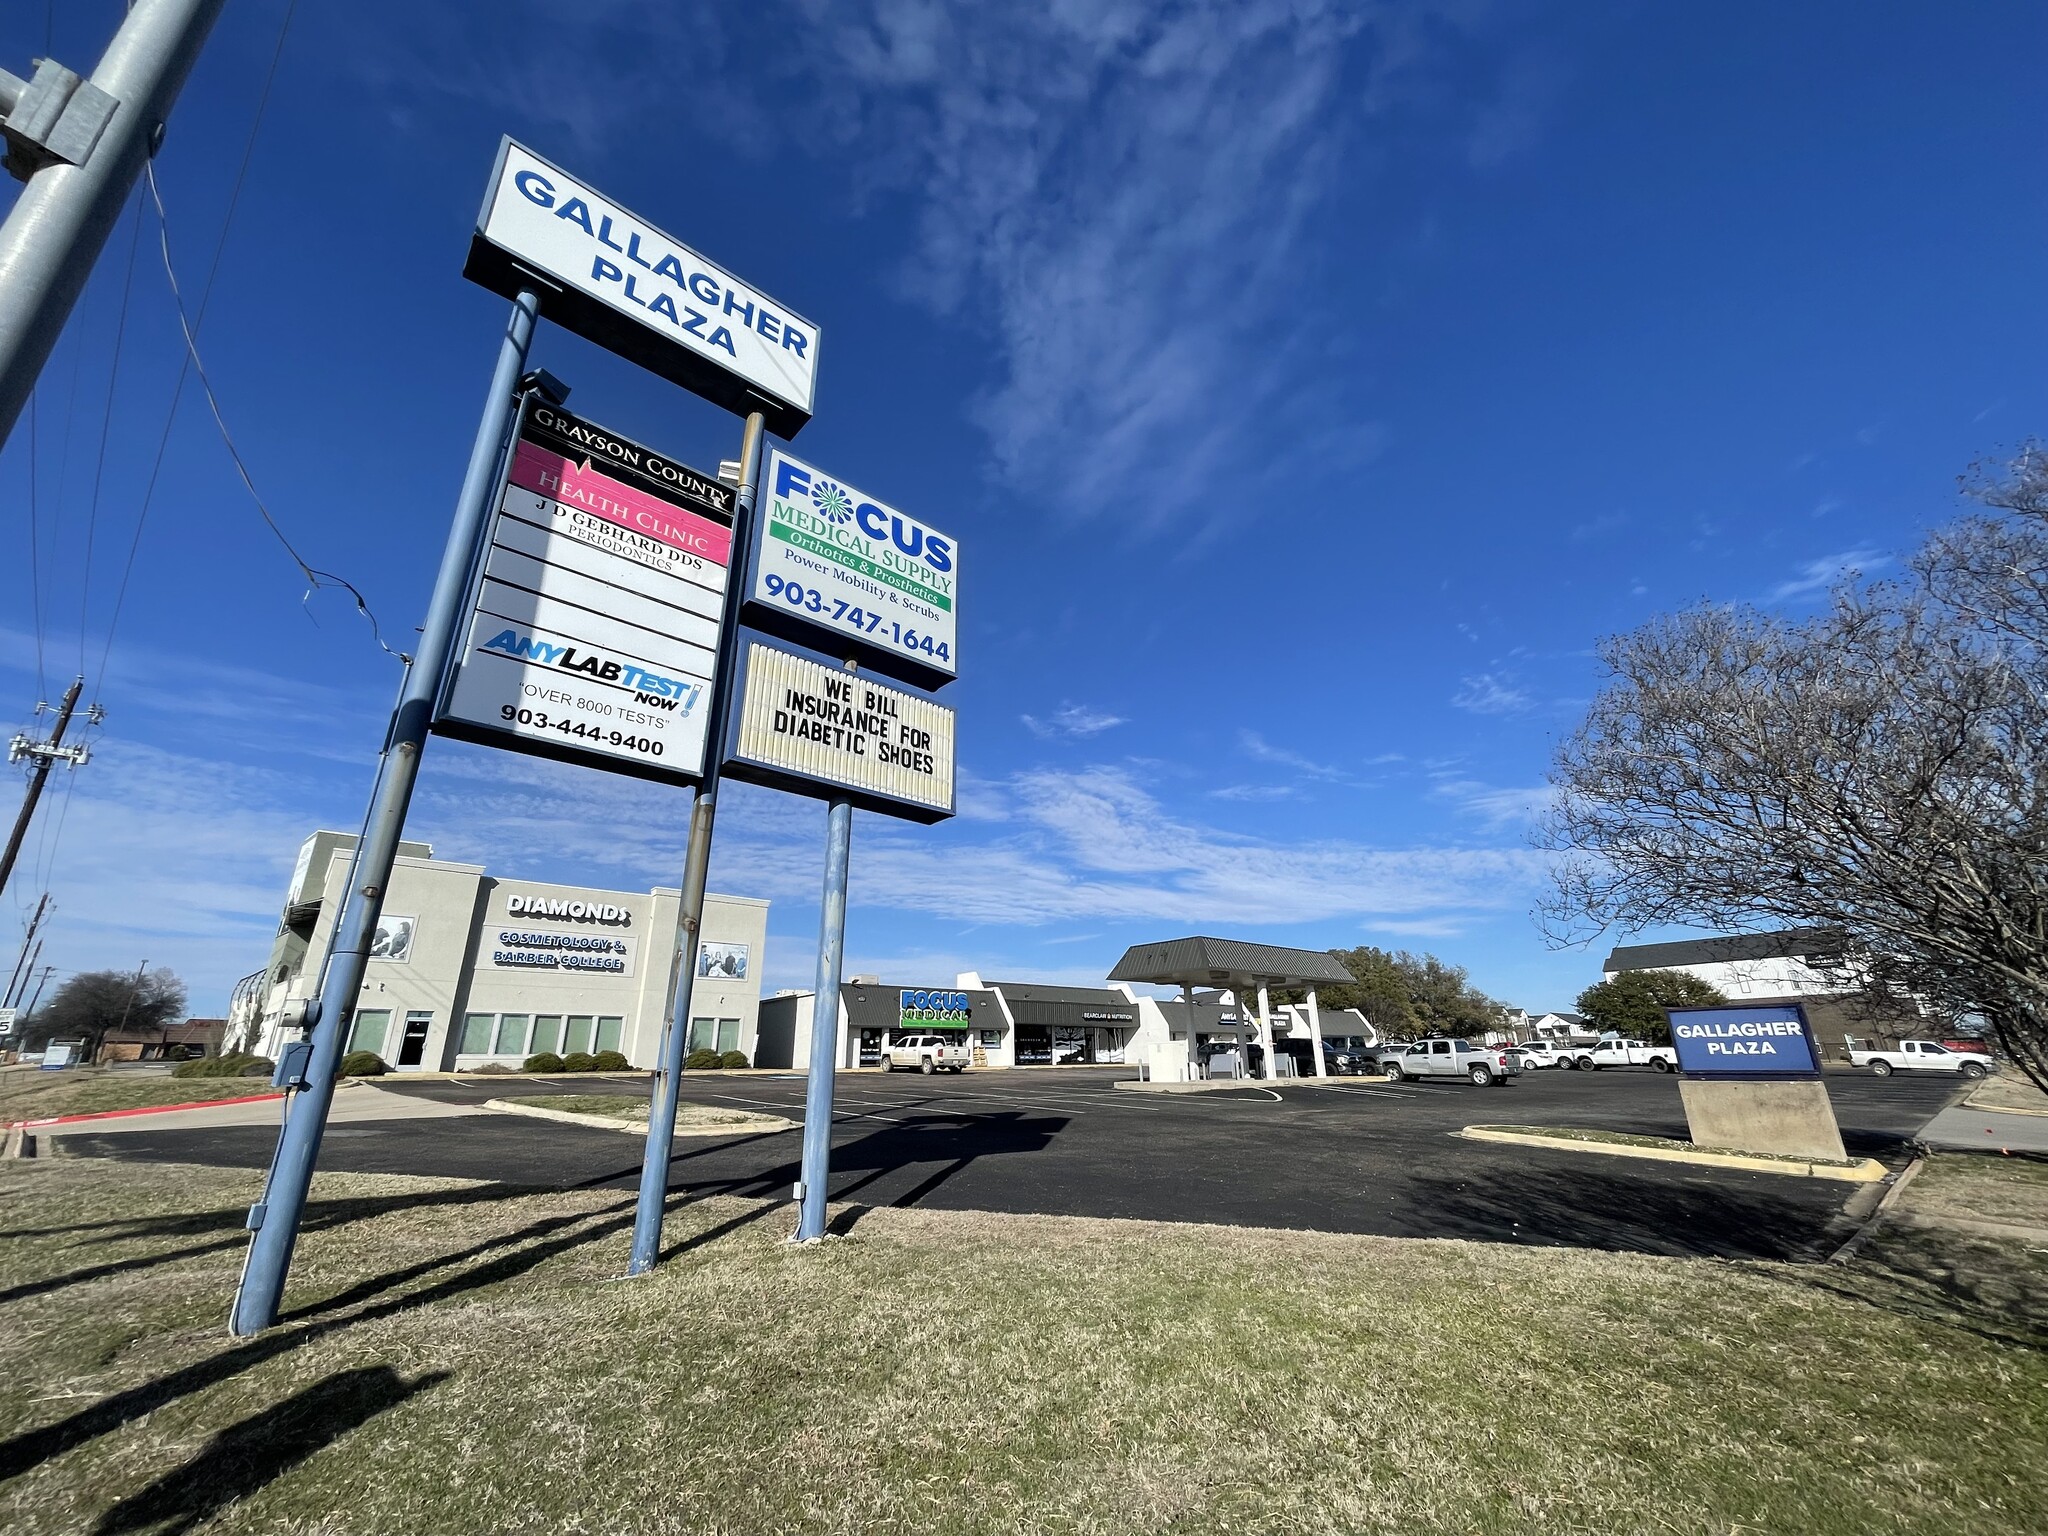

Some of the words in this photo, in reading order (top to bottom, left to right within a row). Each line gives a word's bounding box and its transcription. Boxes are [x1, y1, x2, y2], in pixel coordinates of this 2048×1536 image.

[514, 169, 809, 361] GALLAGHER
[591, 254, 737, 359] PLAZA
[535, 408, 640, 466] GRAYSON
[646, 458, 730, 505] COUNTY
[536, 500, 547, 510] J
[553, 504, 566, 517] D
[573, 512, 663, 555] GEBHARD
[668, 550, 703, 570] DDS
[538, 471, 629, 521] HEALTH
[636, 512, 709, 552] CLINIC
[568, 524, 673, 571] PERIODONTICS
[772, 500, 876, 560] MEDICAL
[882, 550, 952, 595] SUPPLY
[790, 531, 855, 568] Orthotics
[859, 560, 869, 574] &
[873, 566, 939, 604] Prosthetics
[785, 548, 829, 575] Power
[833, 567, 887, 600] Mobility
[889, 592, 899, 605] &
[902, 597, 940, 622] Scrubs
[765, 573, 950, 663] 903-747-1644
[576, 697, 613, 716] 8000
[786, 689, 889, 739] INSURANCE
[900, 724, 931, 751] FOR
[825, 676, 851, 702] WE
[865, 691, 898, 719] BILL
[500, 704, 665, 756] 903-444-9400
[774, 710, 866, 756] DIABETIC
[878, 741, 934, 775] SHOES
[506, 894, 629, 922] DIAMONDS
[493, 951, 556, 966] BARBER
[560, 955, 622, 970] COLLEGE
[499, 932, 609, 950] COSMETOLOGY
[613, 939, 624, 951] &
[900, 990, 970, 1011] FOCUS
[901, 1009, 969, 1021] MEDICAL
[1676, 1021, 1803, 1038] GALLAGHER
[1707, 1041, 1777, 1055] PLAZA
